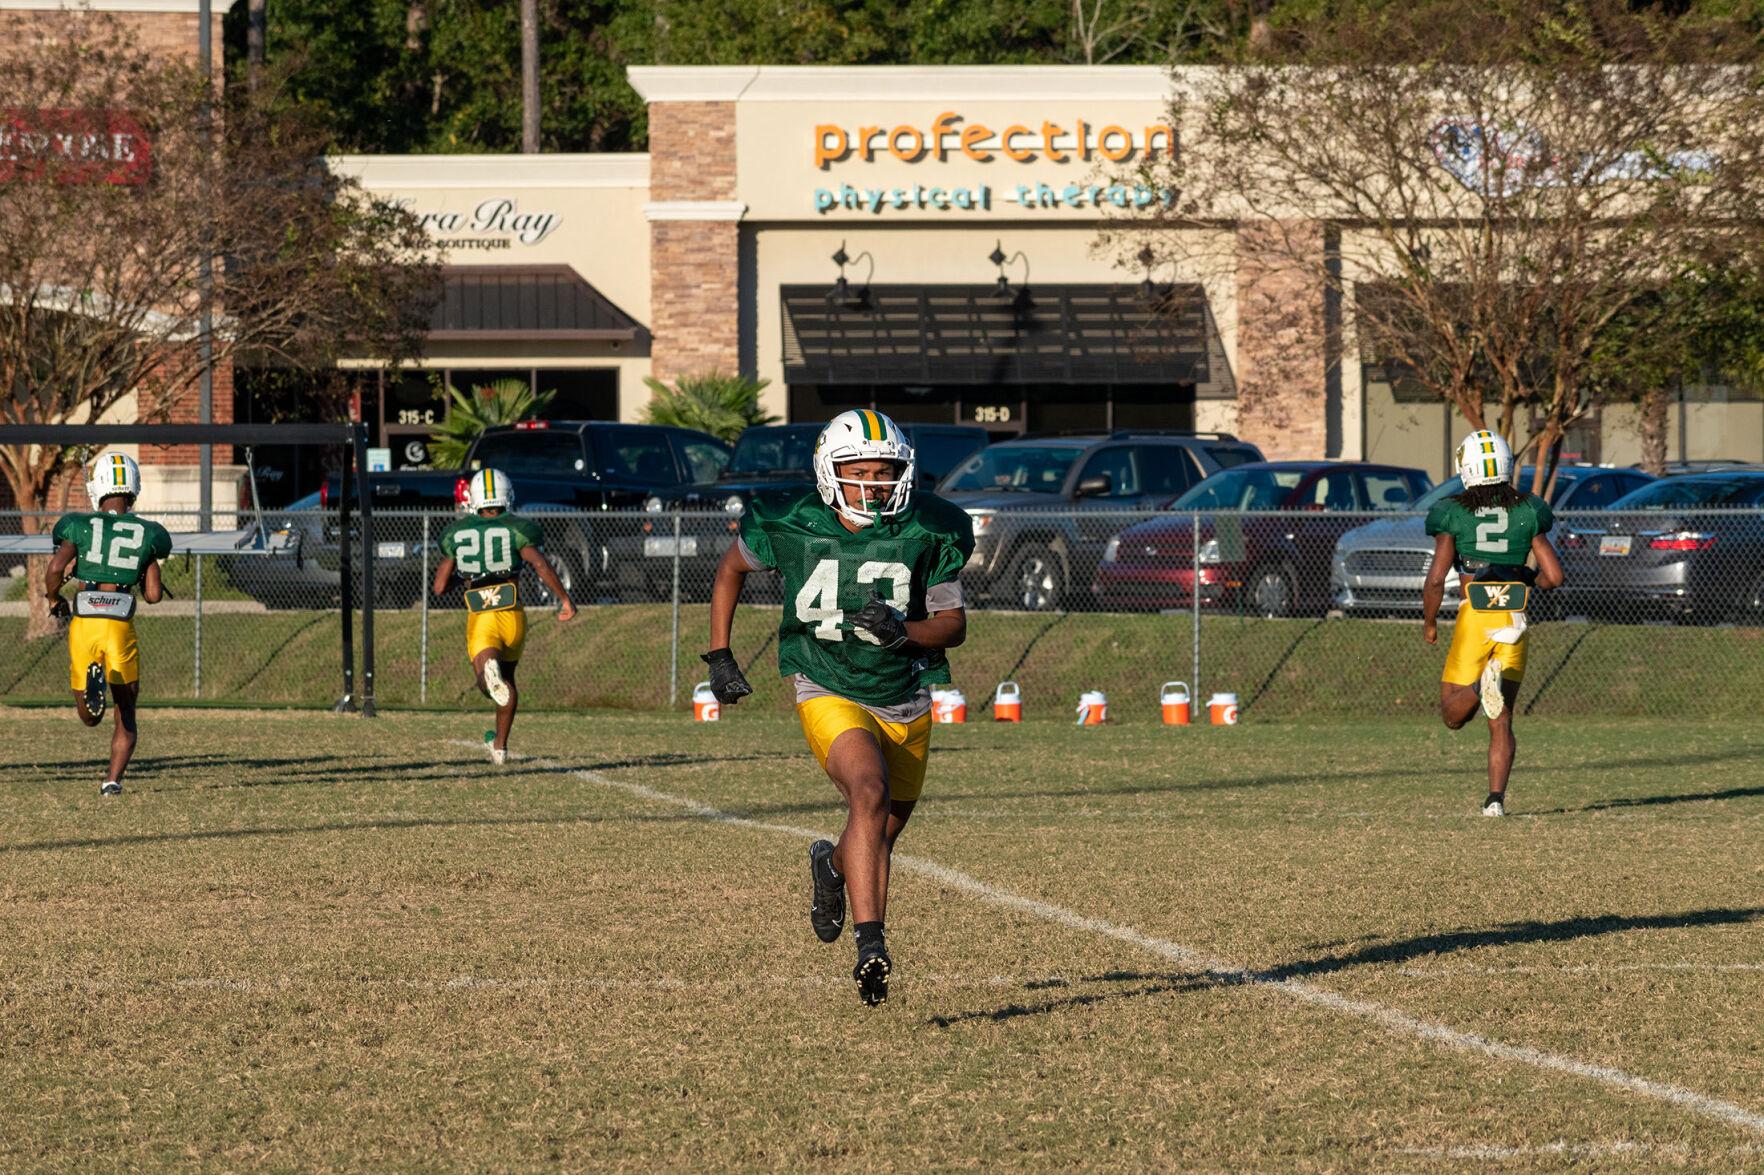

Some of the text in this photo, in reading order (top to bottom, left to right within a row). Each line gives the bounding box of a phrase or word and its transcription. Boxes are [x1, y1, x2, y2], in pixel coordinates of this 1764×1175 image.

[815, 111, 1175, 169] profection
[814, 182, 991, 214] physical
[437, 238, 511, 251] BOUTIQUE
[469, 197, 563, 247] Ray
[398, 409, 434, 425] 315-C
[86, 517, 145, 570] 12
[454, 527, 512, 573] 20
[1474, 506, 1509, 553] 2
[88, 595, 121, 606] schutt
